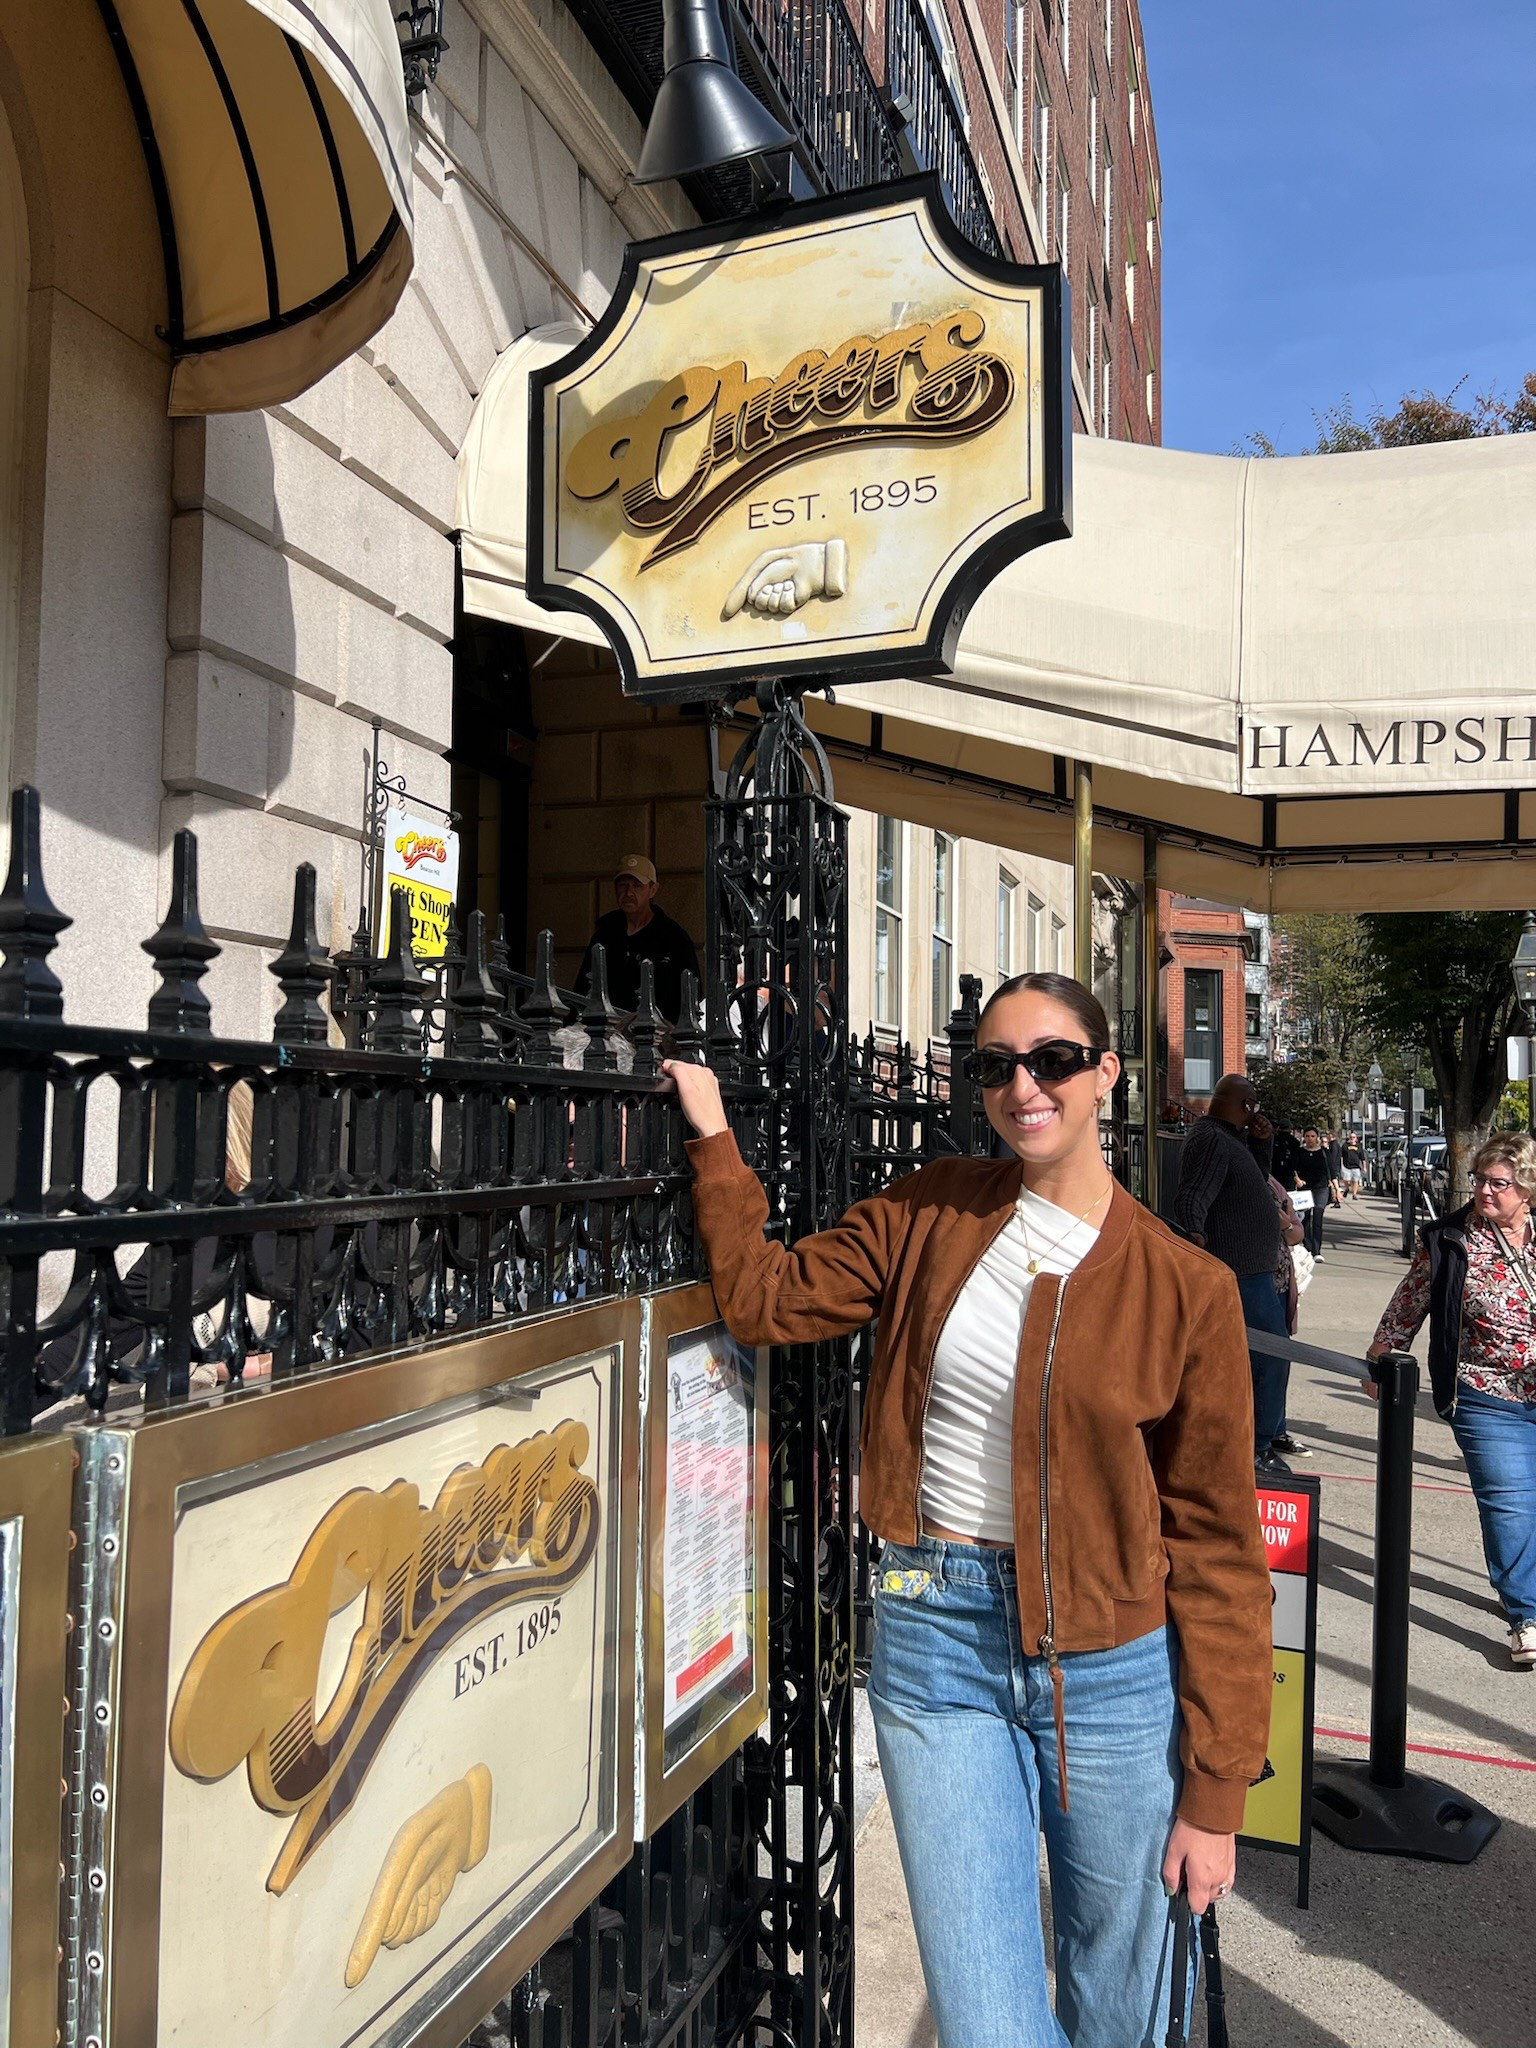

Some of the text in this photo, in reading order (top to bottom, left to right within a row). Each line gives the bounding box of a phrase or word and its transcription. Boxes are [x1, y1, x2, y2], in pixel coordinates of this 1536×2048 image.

[565, 309, 1016, 576] Cheers
[748, 475, 938, 530] EST. 1895
[1246, 716, 1536, 769] HAMPSH
[395, 831, 447, 870] Cheers
[390, 882, 450, 922] ft Shop
[412, 917, 443, 944] PEN
[1266, 1499, 1297, 1523] FOR
[169, 1418, 601, 1898] Cheers
[452, 1597, 562, 1700] EST. 1895
